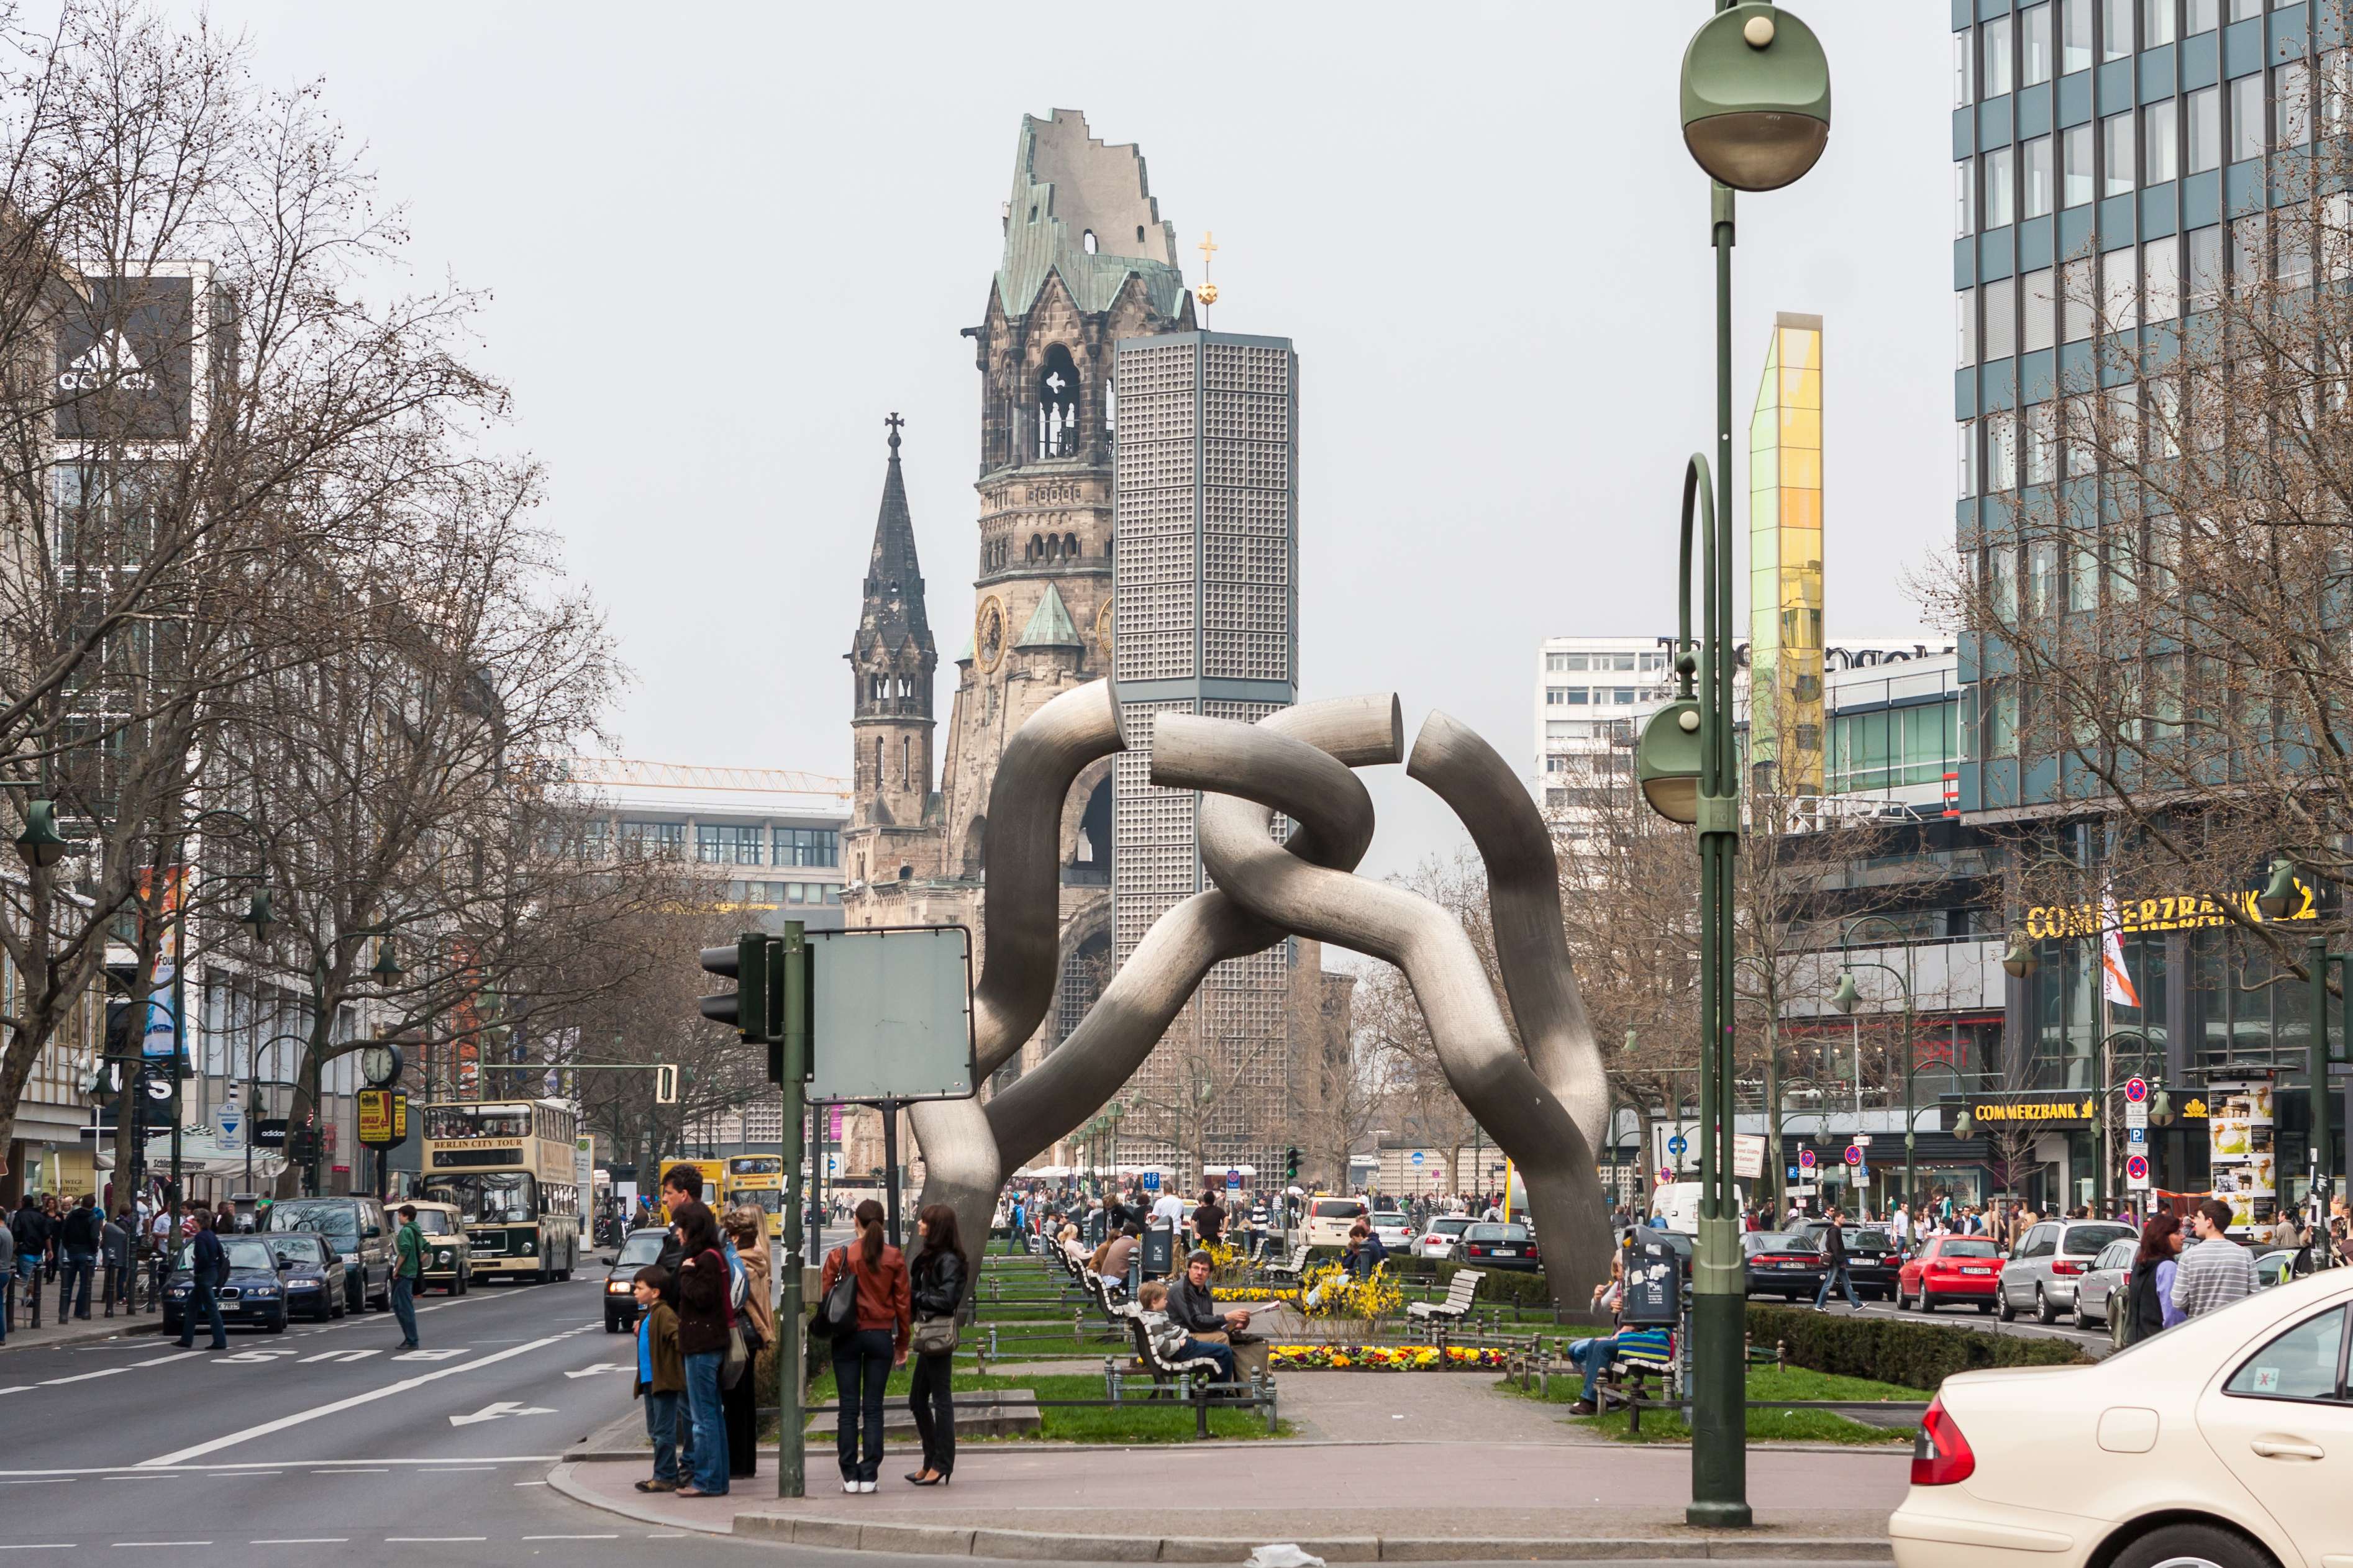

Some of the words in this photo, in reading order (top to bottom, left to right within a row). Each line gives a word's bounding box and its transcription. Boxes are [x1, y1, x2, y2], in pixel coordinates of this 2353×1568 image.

[2027, 890, 2263, 939] COMERZBANK
[1975, 1103, 2077, 1120] COMMERZBANK
[434, 1140, 468, 1148] BERLIN
[471, 1140, 494, 1148] CITY
